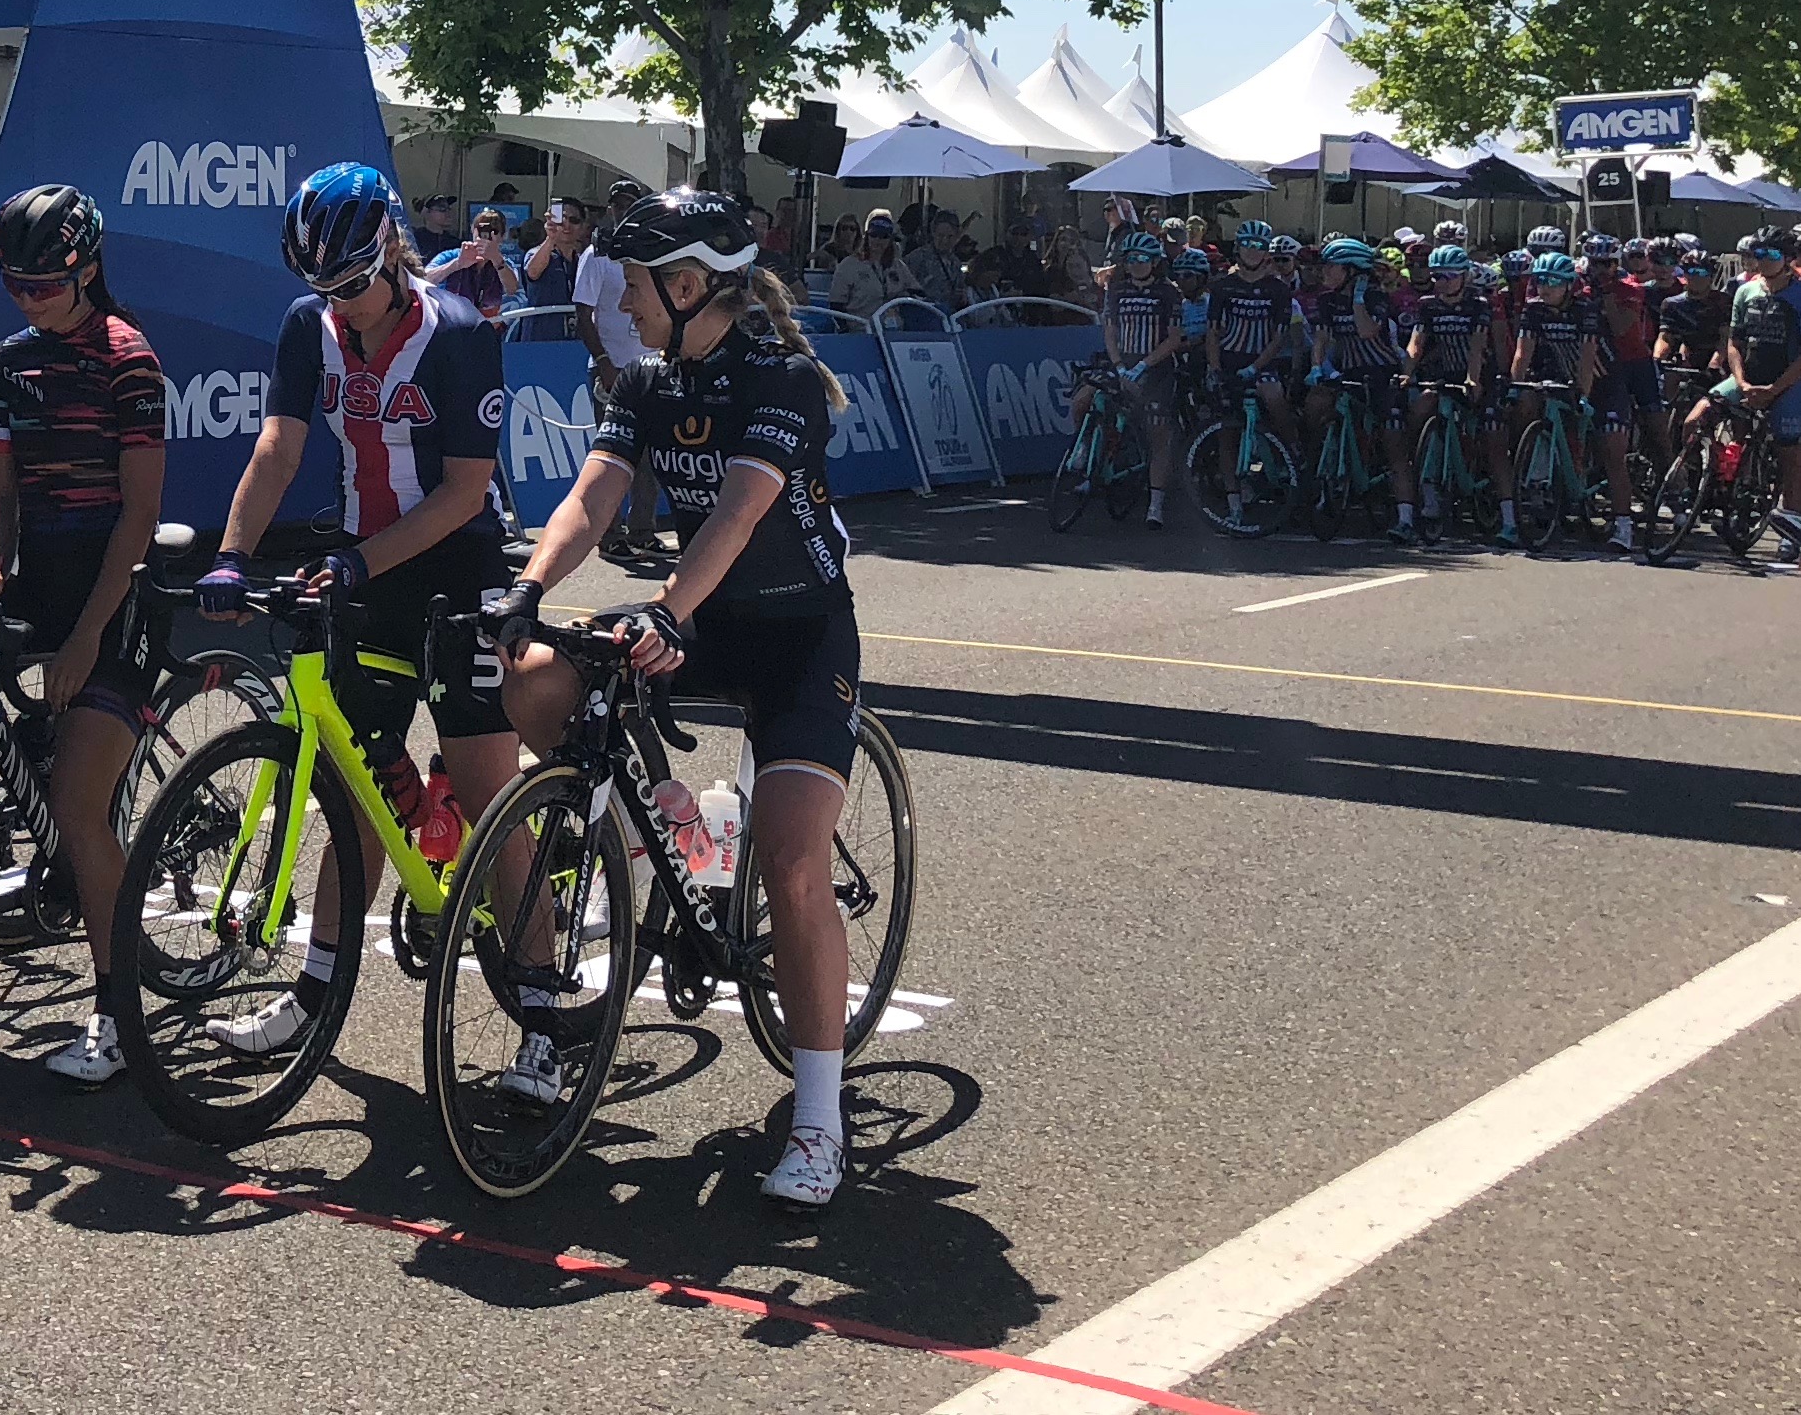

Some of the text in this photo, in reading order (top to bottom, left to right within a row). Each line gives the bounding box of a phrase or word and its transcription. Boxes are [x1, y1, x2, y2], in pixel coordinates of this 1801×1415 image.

[1566, 107, 1680, 141] AMGEN
[122, 140, 286, 209] AMGEN
[1598, 172, 1620, 187] 25
[70, 224, 87, 247] GIRO
[163, 370, 270, 441] MGE
[321, 371, 437, 427] USA
[605, 403, 636, 419] NDA
[754, 406, 806, 427] HONDA
[986, 357, 1087, 439] AMG
[599, 422, 635, 440] GH5
[625, 753, 719, 933] COLNAGO
[572, 849, 591, 945] COLNAGO
